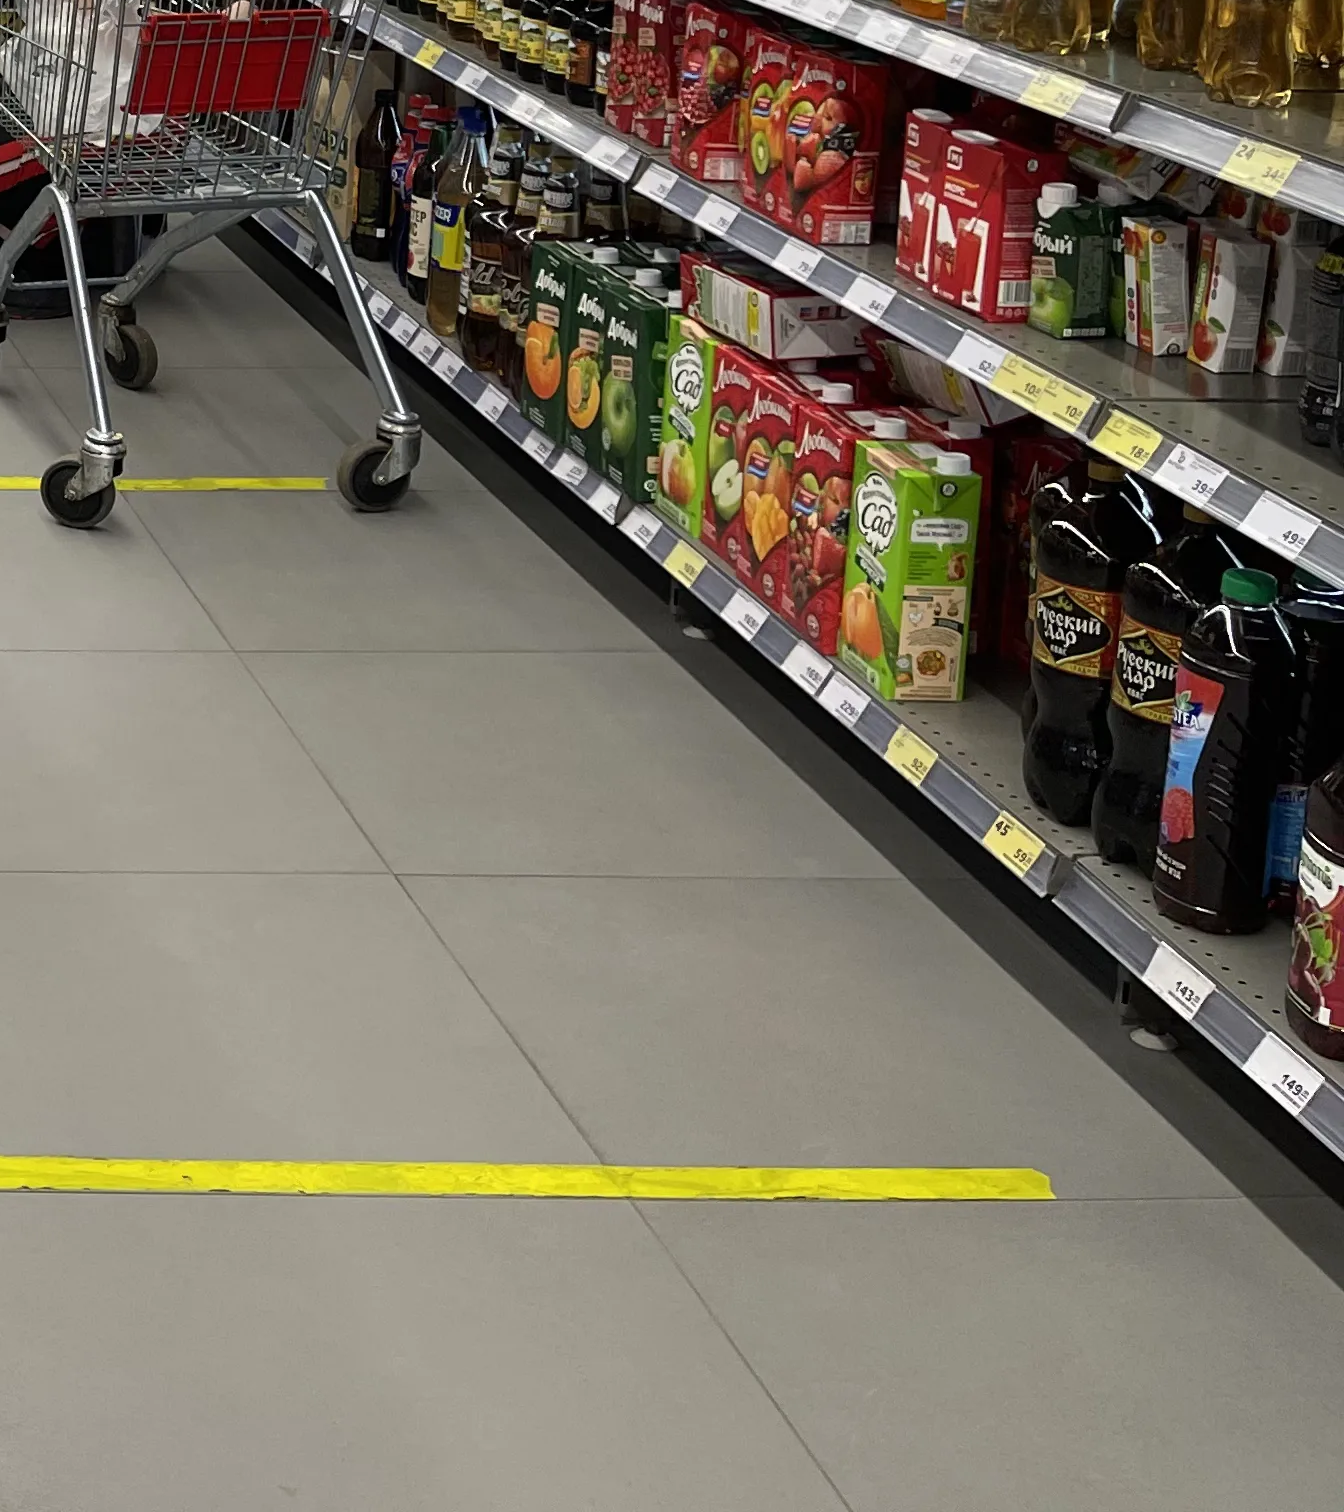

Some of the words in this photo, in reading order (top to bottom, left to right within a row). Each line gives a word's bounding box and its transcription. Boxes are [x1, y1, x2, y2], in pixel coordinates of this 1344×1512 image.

[1236, 144, 1253, 159] 24
[1264, 166, 1279, 180] 34
[535, 269, 567, 301] Добрый
[577, 293, 605, 323] Добры
[607, 317, 638, 349] Добрый
[674, 368, 702, 400] Сад
[795, 421, 842, 463] Любимый
[1192, 480, 1208, 494] 39
[861, 502, 893, 538] Сад
[1282, 529, 1301, 545] 49
[1036, 598, 1102, 636] Русский
[1044, 626, 1078, 648] Дар
[1116, 642, 1178, 681] Русский
[1122, 665, 1156, 693] Дар
[995, 819, 1011, 838] 45
[1013, 849, 1027, 864] 59
[1175, 981, 1194, 1001] 143
[1280, 1074, 1302, 1094] 149
